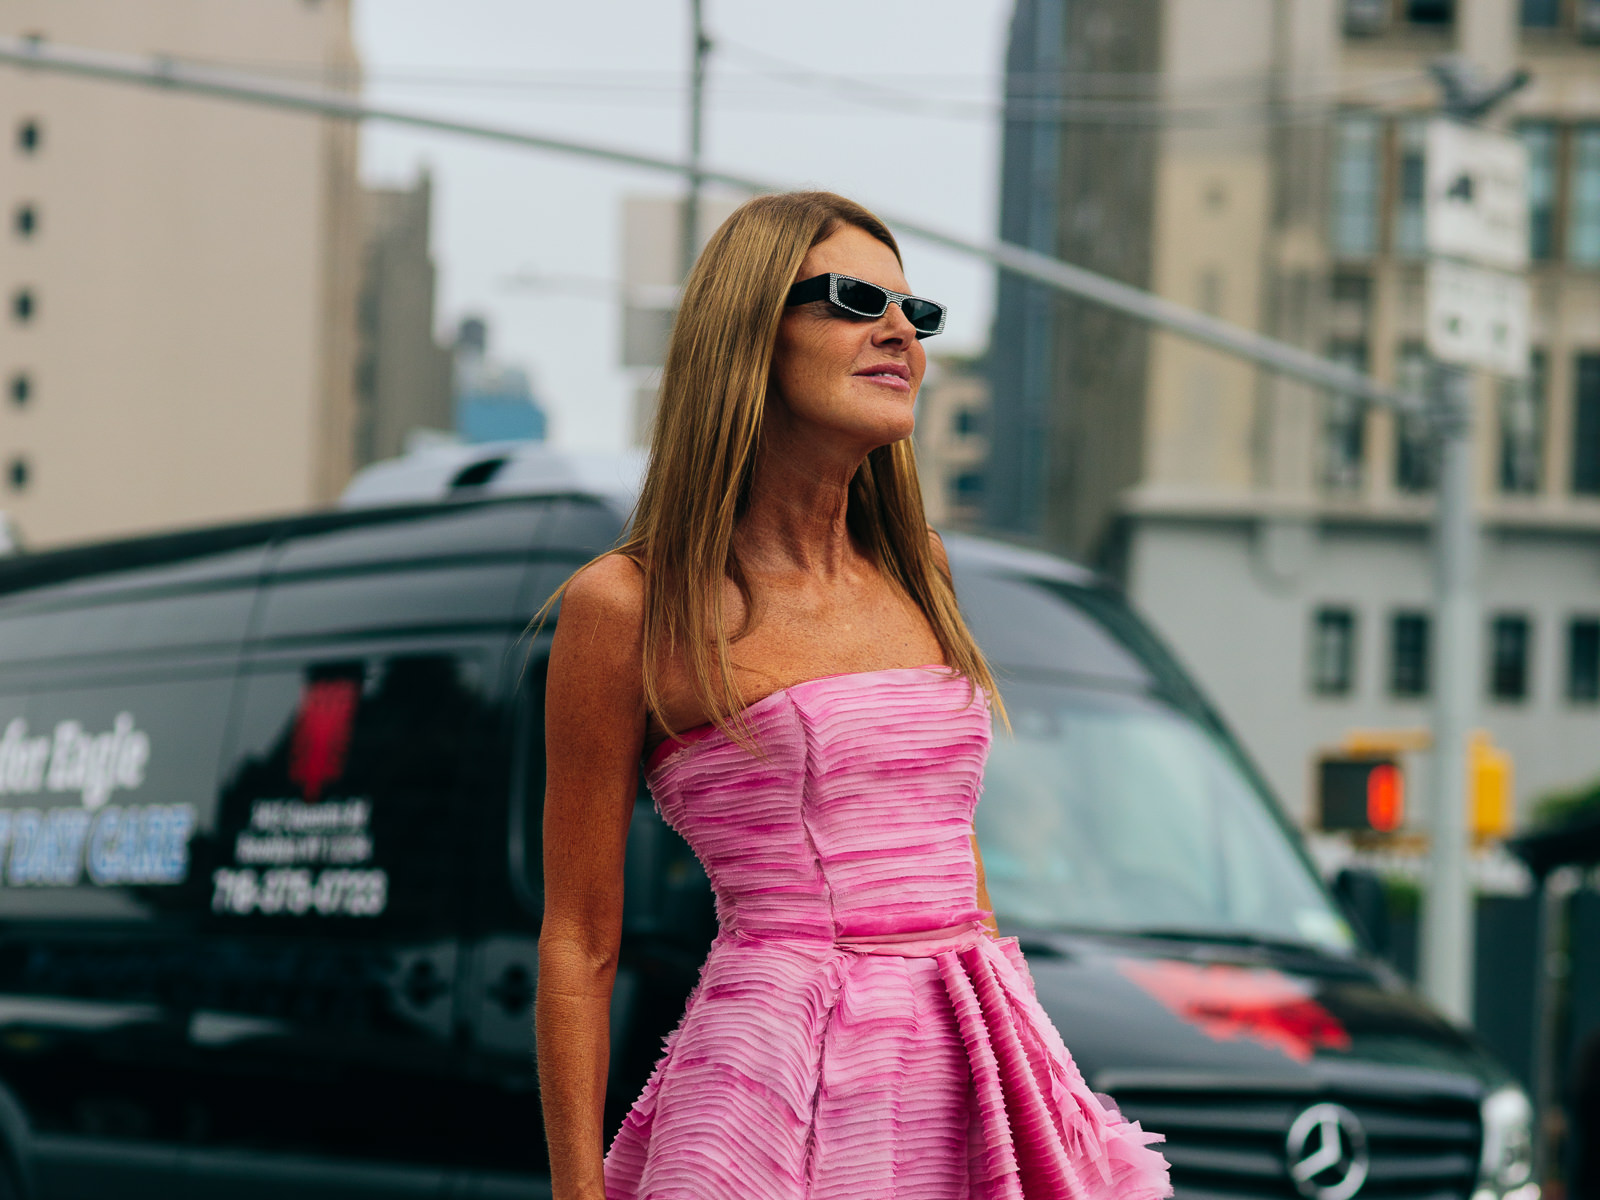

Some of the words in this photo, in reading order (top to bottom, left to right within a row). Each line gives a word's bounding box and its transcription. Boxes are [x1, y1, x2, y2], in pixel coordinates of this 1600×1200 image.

[48, 711, 150, 810] Eagle
[9, 806, 92, 886] DAY
[87, 803, 195, 886] CARE
